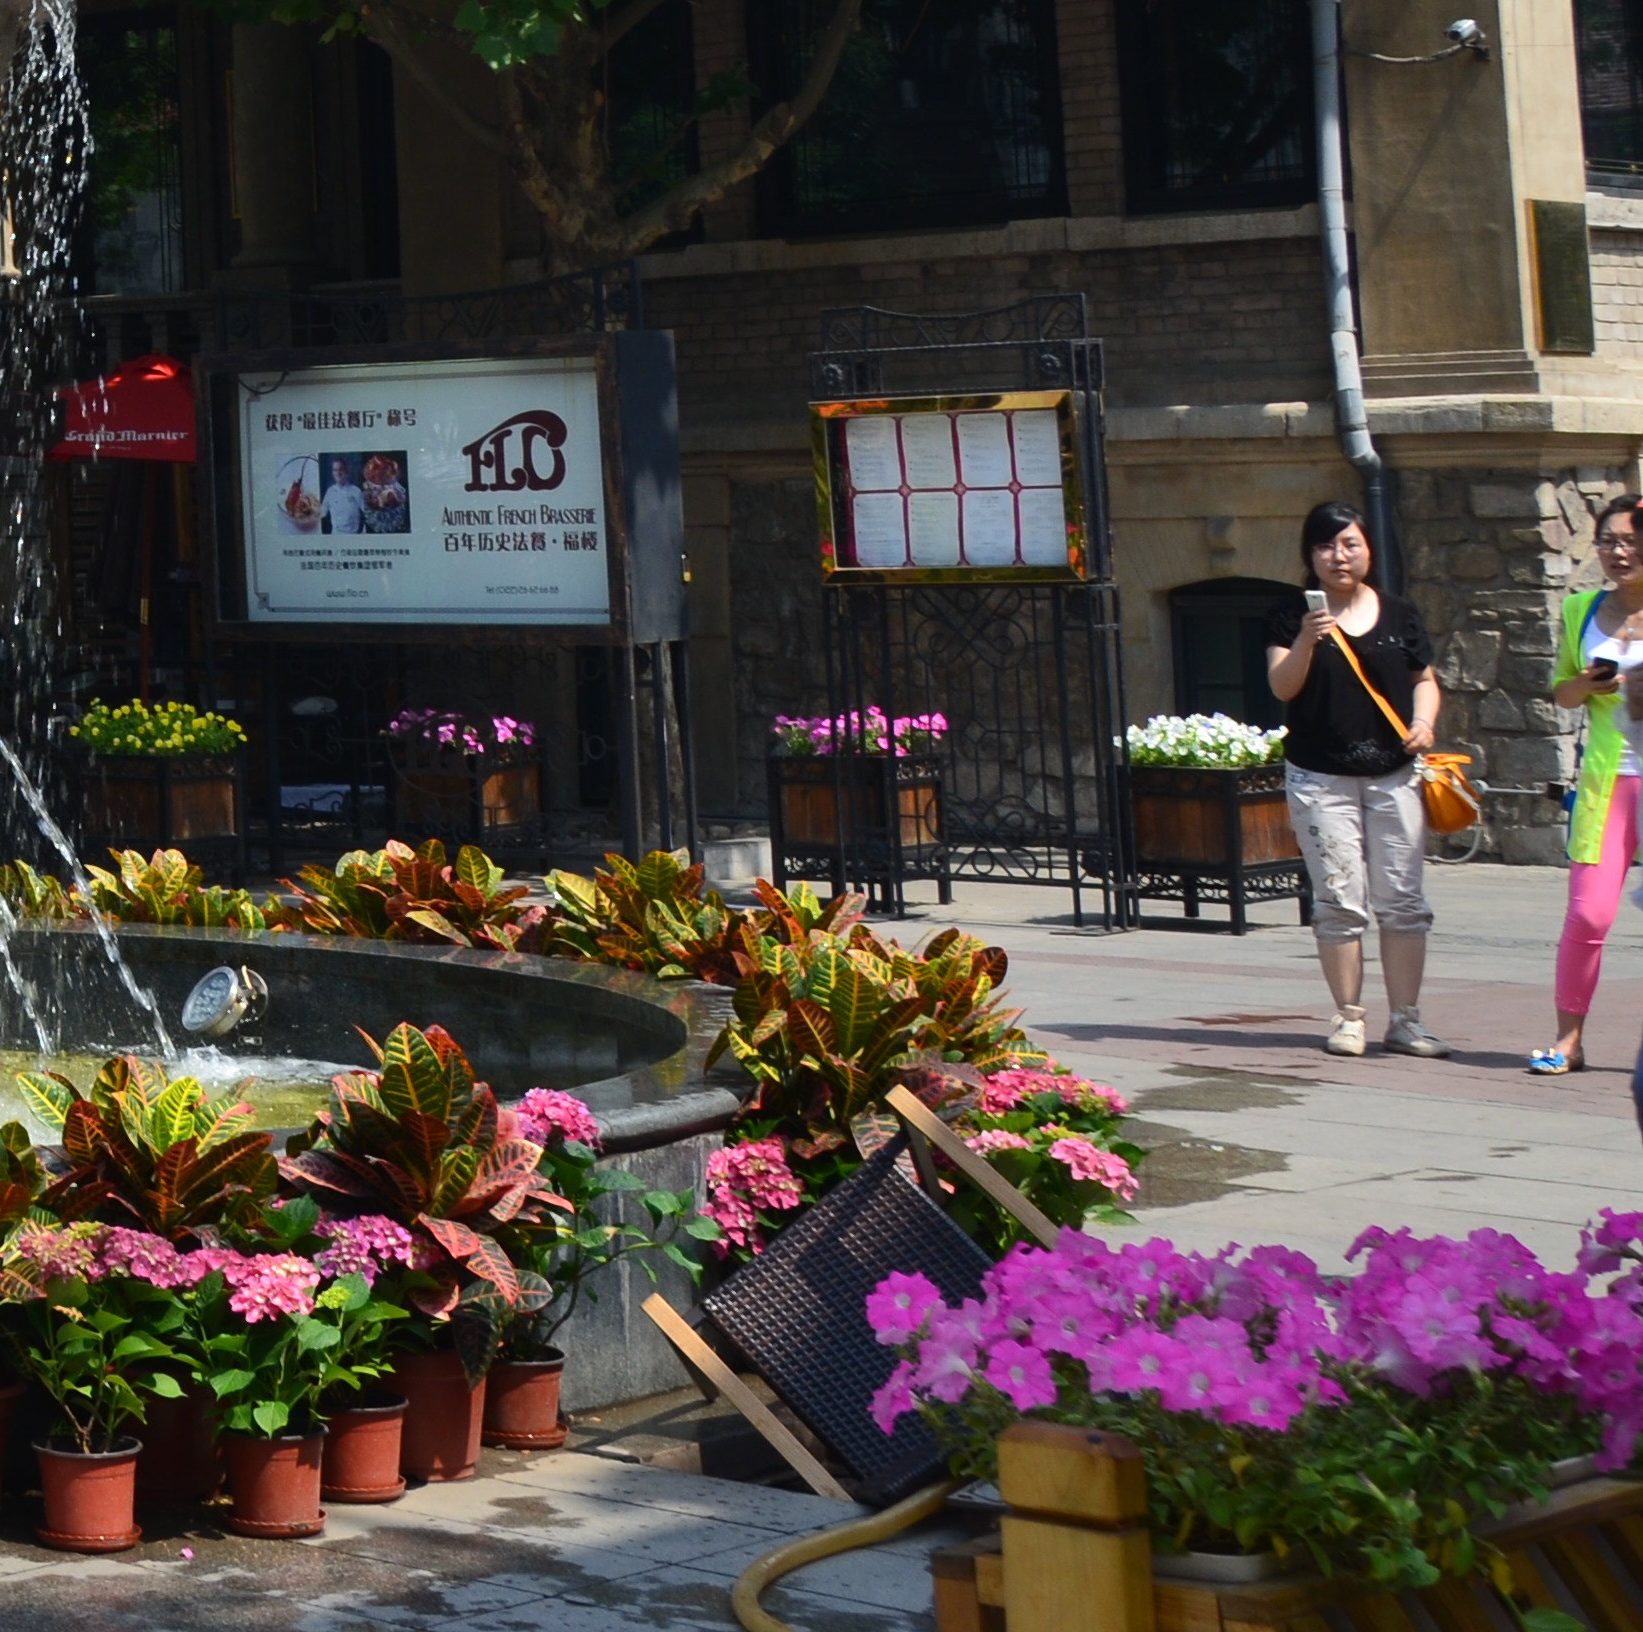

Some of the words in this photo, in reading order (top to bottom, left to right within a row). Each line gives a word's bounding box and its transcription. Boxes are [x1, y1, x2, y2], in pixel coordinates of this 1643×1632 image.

[65, 429, 115, 443] Grand
[116, 429, 188, 442] Marnier
[462, 410, 568, 493] FLO
